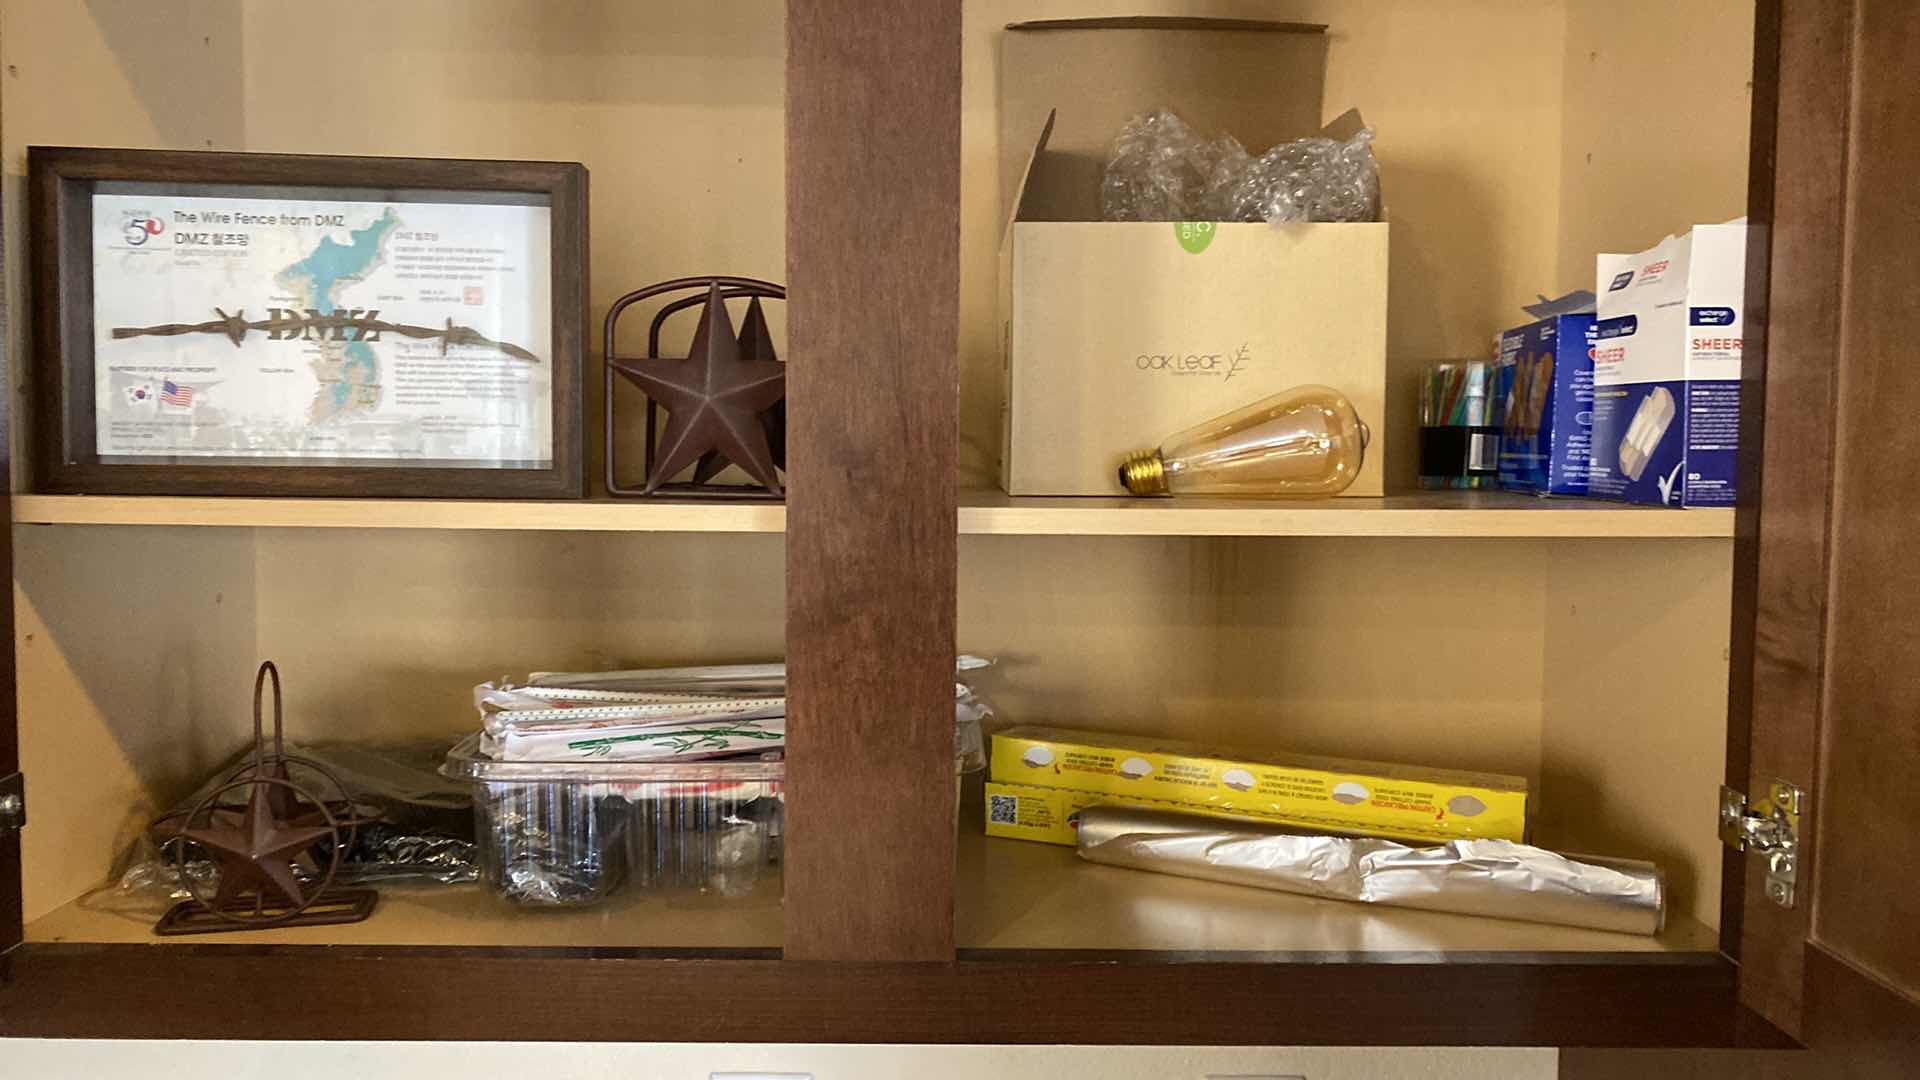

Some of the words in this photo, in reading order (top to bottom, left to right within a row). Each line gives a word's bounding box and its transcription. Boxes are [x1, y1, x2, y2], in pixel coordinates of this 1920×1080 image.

[173, 210, 197, 224] The
[200, 211, 230, 225] Wire
[234, 212, 276, 225] Fence
[280, 213, 311, 226] from
[315, 214, 345, 227] DMZ
[174, 231, 209, 246] DMZ
[1692, 338, 1744, 351] SHEER
